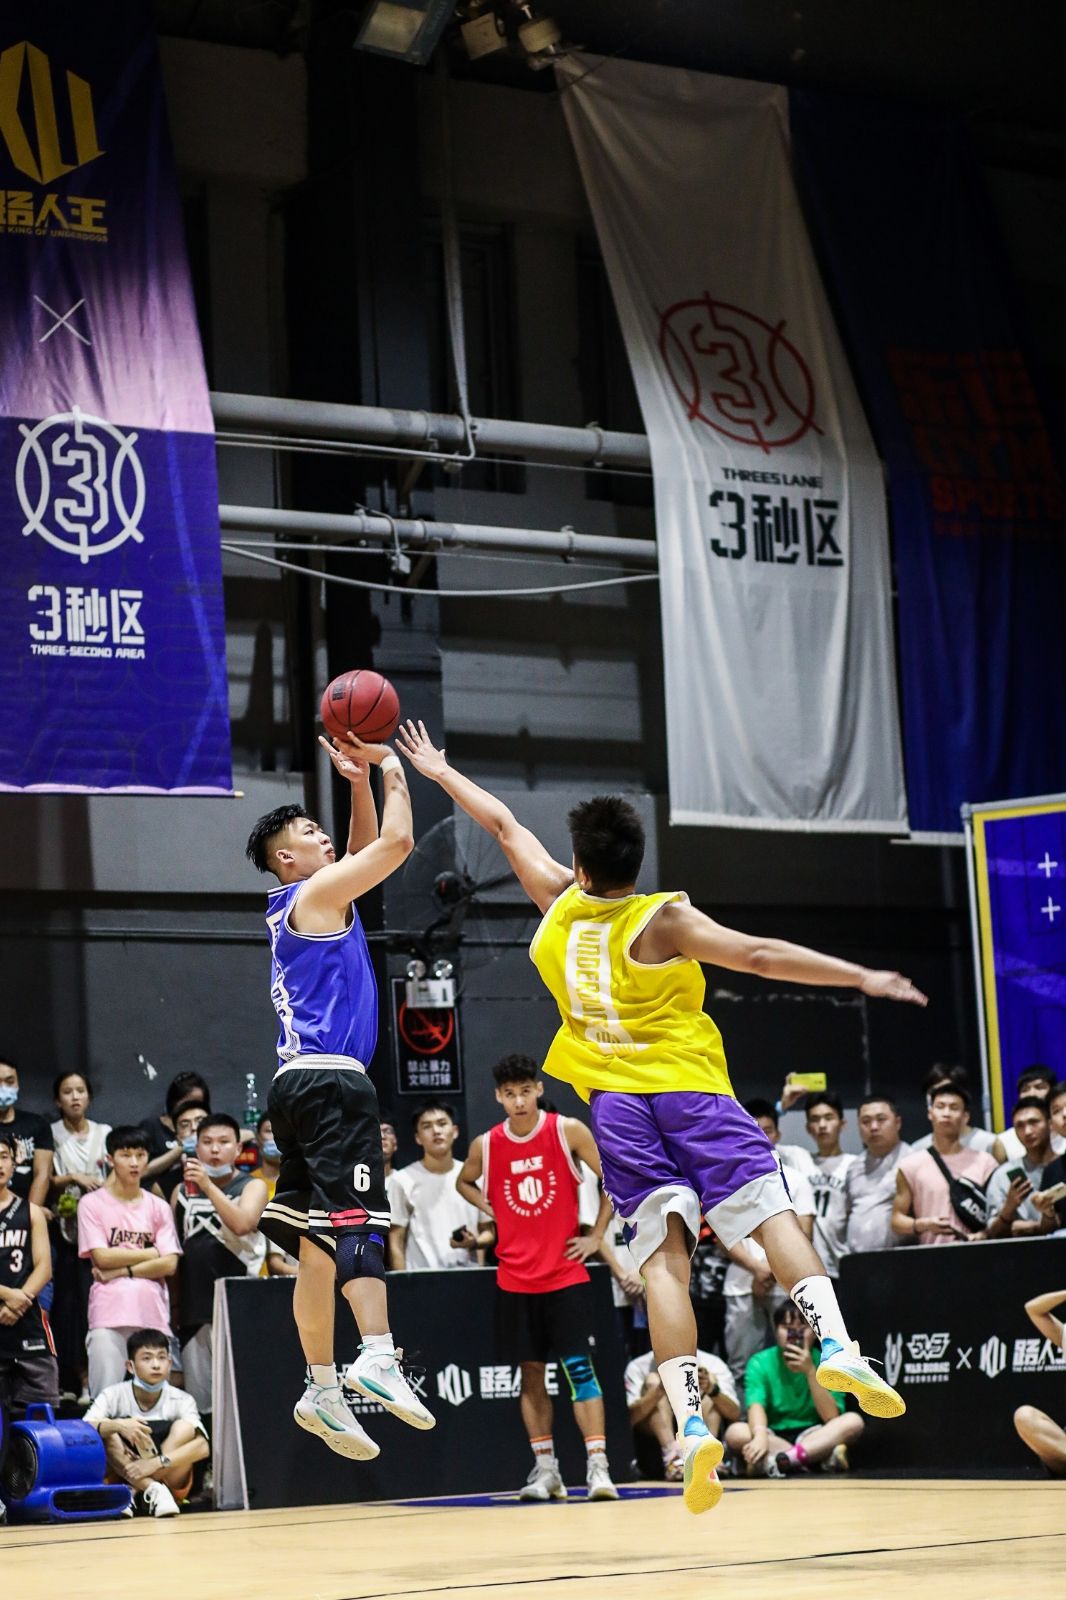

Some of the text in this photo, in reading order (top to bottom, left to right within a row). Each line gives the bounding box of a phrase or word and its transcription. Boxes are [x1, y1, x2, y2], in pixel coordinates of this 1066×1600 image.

[0, 190, 107, 234] 路人王
[782, 473, 823, 488] LANE
[709, 490, 844, 566] 3秒区
[28, 585, 145, 644] 3秒区
[30, 644, 145, 659] THREE-SECOND AREA
[353, 1163, 371, 1192] 6
[814, 1190, 831, 1217] 11
[10, 1249, 23, 1272] 3
